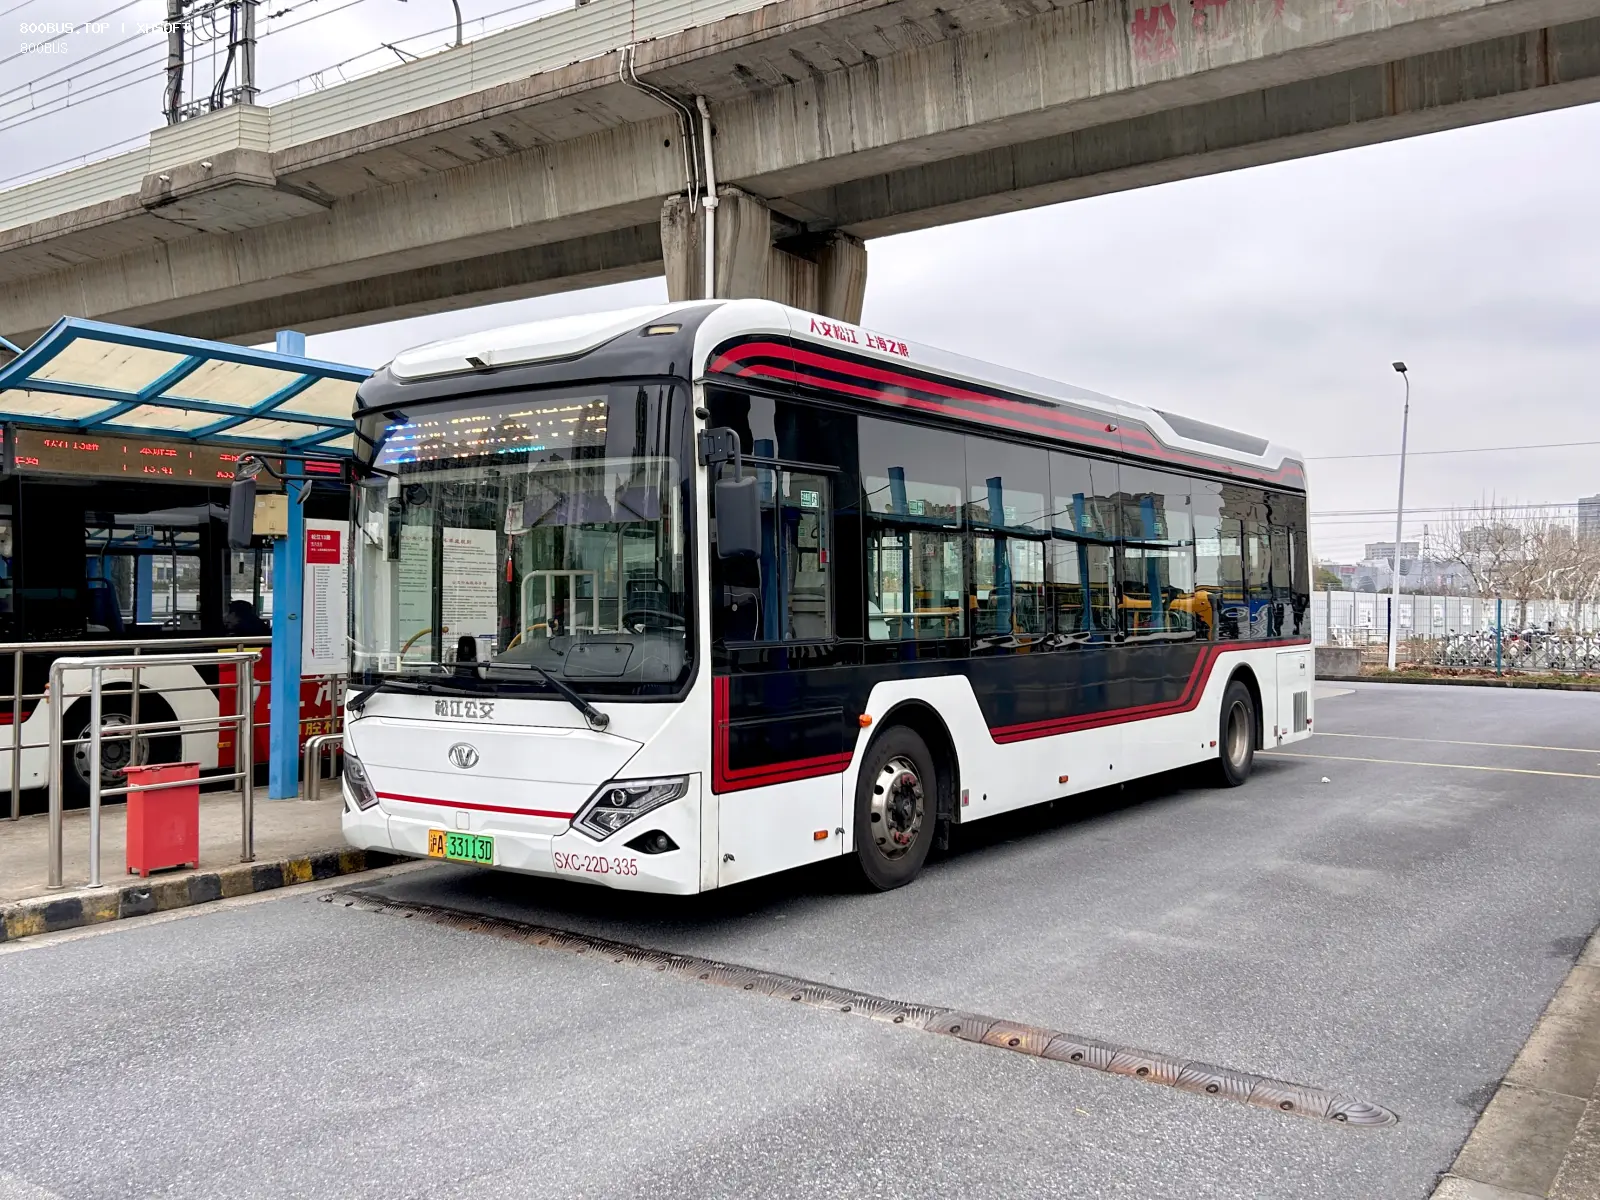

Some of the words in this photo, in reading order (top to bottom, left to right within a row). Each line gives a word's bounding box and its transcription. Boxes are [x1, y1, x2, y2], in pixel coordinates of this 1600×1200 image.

[810, 317, 859, 344] 人文松江
[865, 333, 909, 357] 上海之根
[434, 699, 495, 719] 松江公交
[449, 836, 492, 861] 33113D
[554, 851, 638, 876] SXC-22D-335
